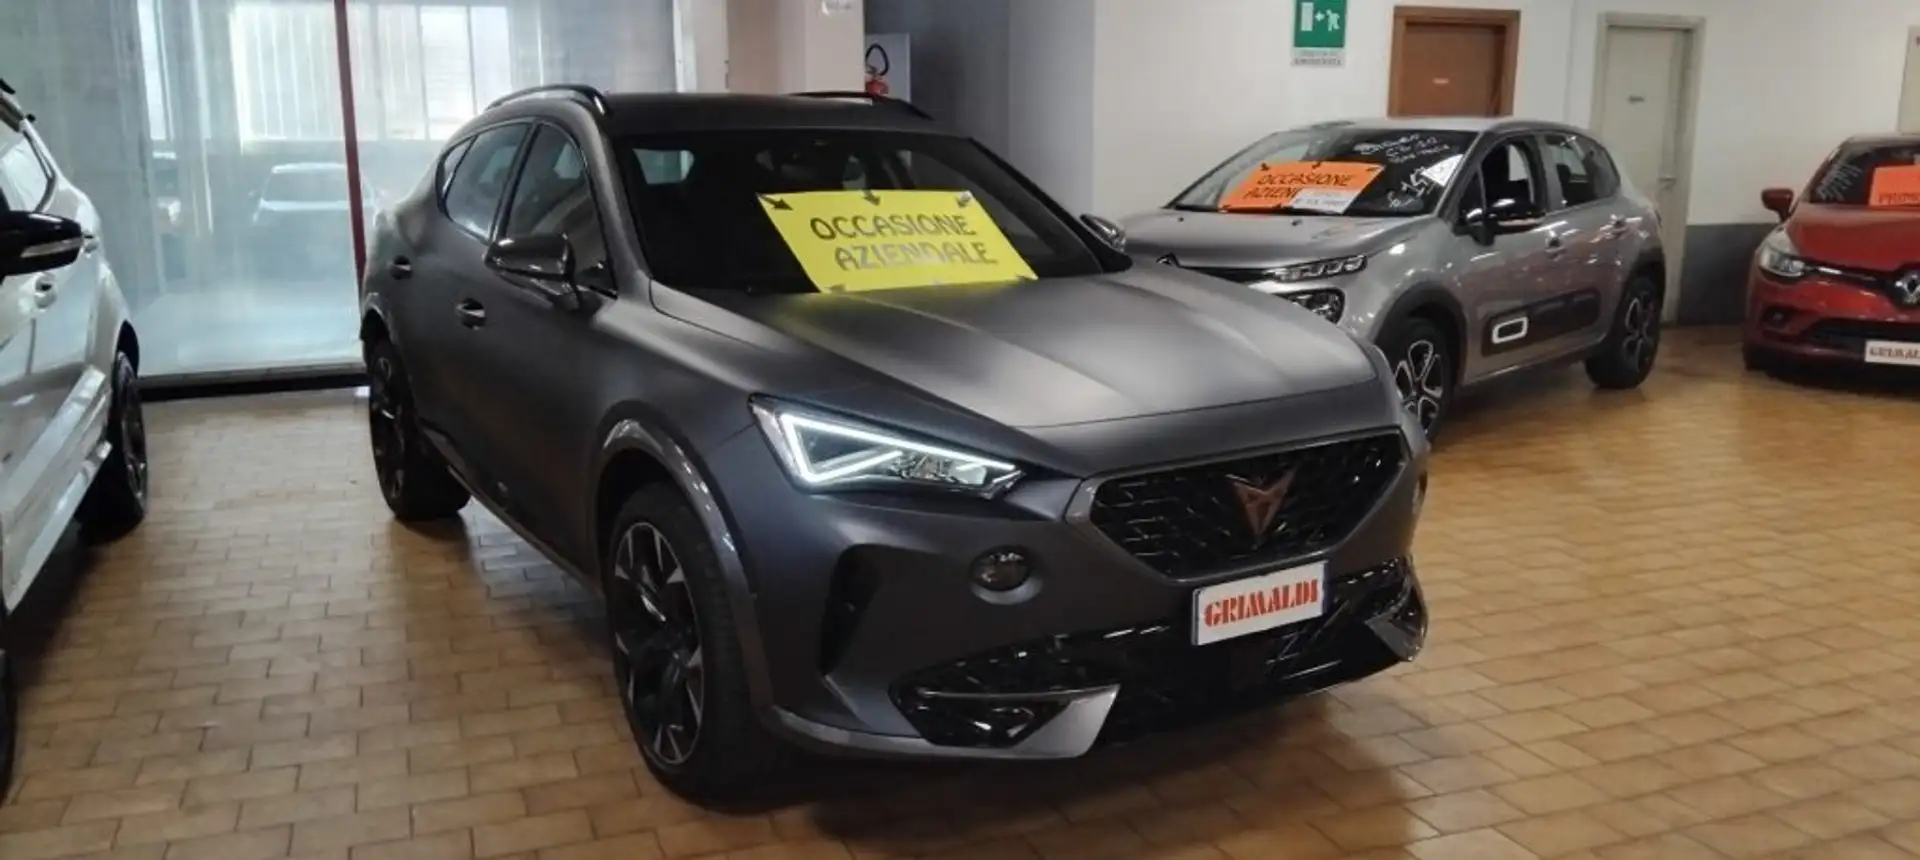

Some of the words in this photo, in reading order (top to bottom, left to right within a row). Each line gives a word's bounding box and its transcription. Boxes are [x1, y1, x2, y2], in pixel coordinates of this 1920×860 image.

[810, 214, 977, 241] OCCASIONE
[834, 241, 999, 271] AZIENDALE
[1204, 579, 1318, 628] GRIMALDI
